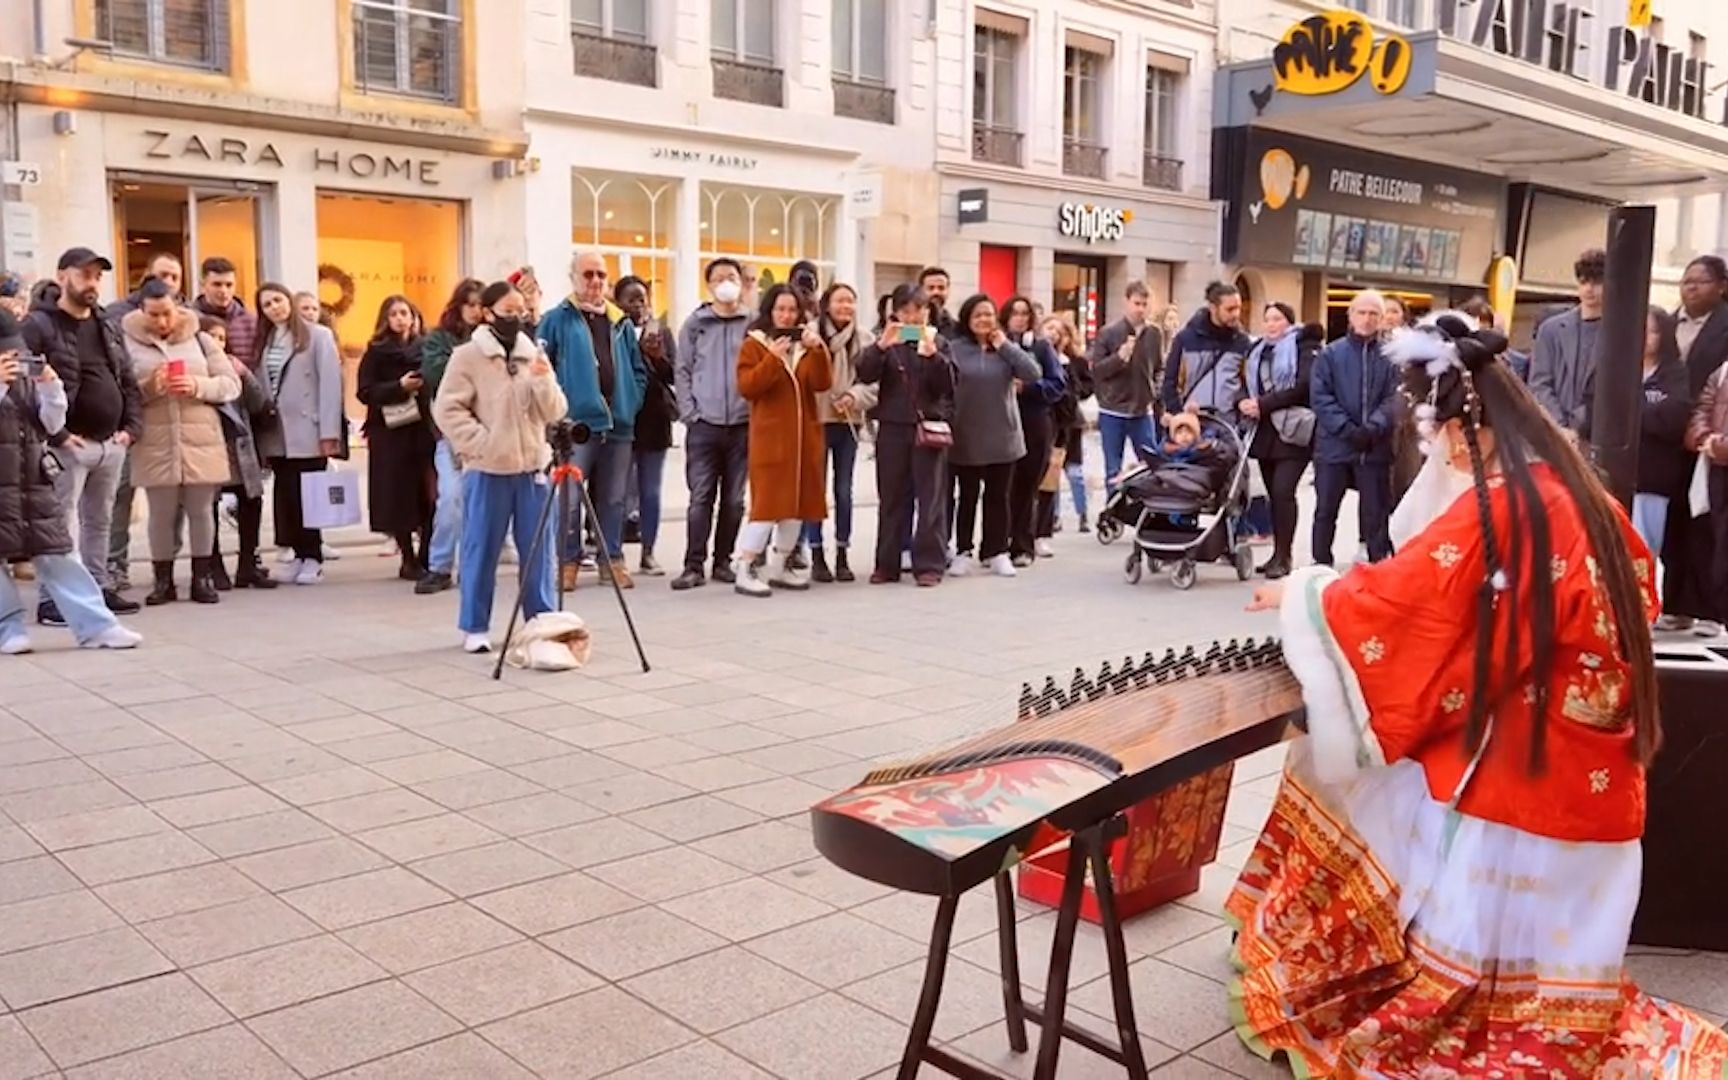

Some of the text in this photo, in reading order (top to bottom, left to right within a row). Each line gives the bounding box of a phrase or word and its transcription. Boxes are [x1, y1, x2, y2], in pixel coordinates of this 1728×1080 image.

[144, 130, 441, 185] ZARA HOME
[652, 147, 758, 169] JIMMY FAIRLY
[17, 169, 38, 183] 73
[1365, 174, 1423, 204] BELLECOUR
[1060, 202, 1125, 244] snipes
